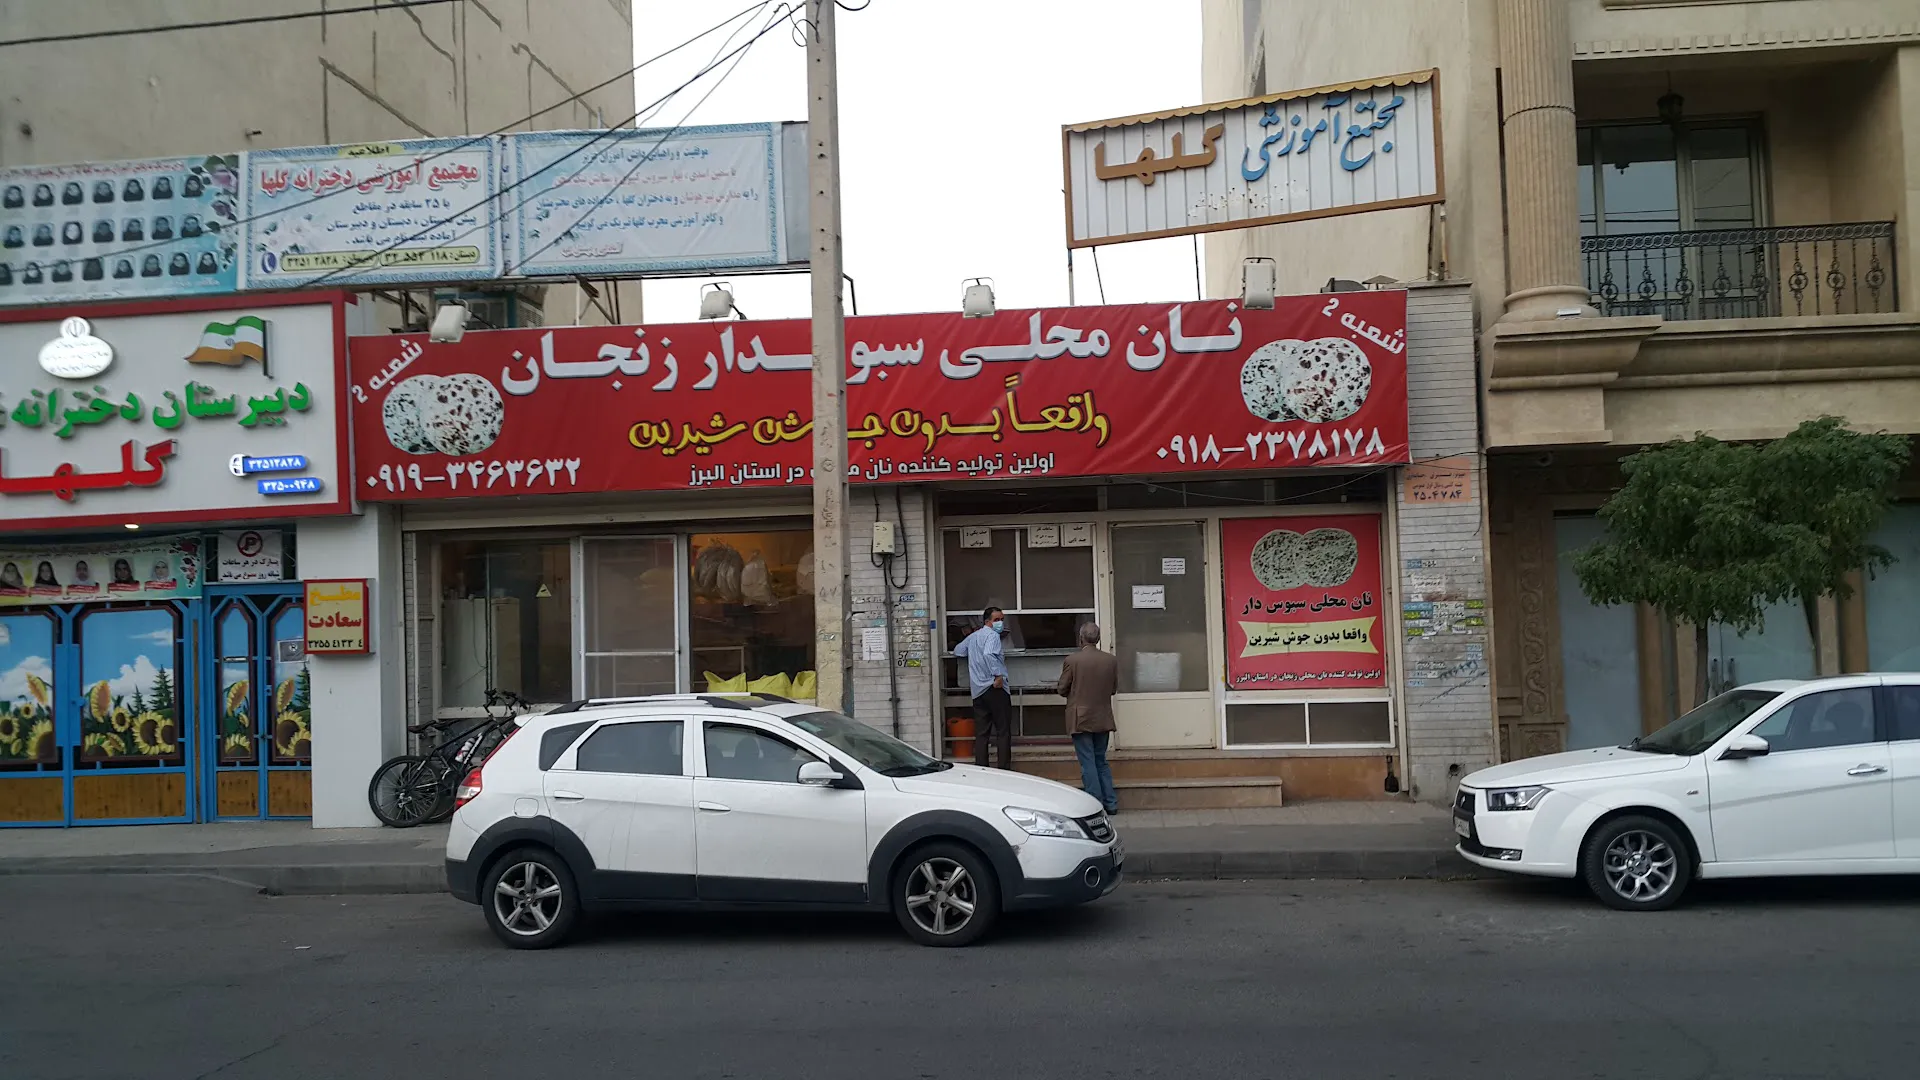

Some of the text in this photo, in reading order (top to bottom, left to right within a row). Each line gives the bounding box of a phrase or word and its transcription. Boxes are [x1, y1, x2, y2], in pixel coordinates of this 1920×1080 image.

[1094, 94, 1406, 187] مجتمع آموزشی گلها
[260, 157, 480, 197] مجتمع آموزشی دخترانه گلها
[1321, 297, 1406, 355] شعبه 2
[501, 301, 1243, 395] نان محلی سبودار زنجان
[351, 339, 424, 404] شعبه 2
[11, 386, 142, 438] دخترانه
[152, 381, 312, 429] دبیرستان
[628, 411, 748, 456] شیرین
[753, 410, 887, 449] جش
[890, 407, 1003, 454] بدون
[1156, 427, 1385, 465] ۰۹۱۸-۲۳۷۸۱۷۸
[0, 439, 177, 503] گله
[729, 462, 781, 485] استان
[785, 464, 804, 483] در
[866, 457, 892, 480] نان
[898, 453, 950, 474] کننده
[957, 453, 1003, 477] تولید
[1009, 452, 1055, 474] اولین
[366, 457, 581, 493] ۰۹۱۹-۳۴۶۳۶۳۲
[689, 464, 725, 486] البرز
[1242, 591, 1373, 615] نان محلی سبوس دار
[309, 611, 362, 628] سعادت
[1249, 629, 1367, 646] واقعا بدون جوش شیرین
[1236, 673, 1250, 683] البرز
[1251, 673, 1268, 682] استان
[1278, 673, 1298, 681] زنجان
[1299, 672, 1316, 681] محلی
[1328, 670, 1346, 678] کننده
[1347, 671, 1363, 679] تولید
[1364, 670, 1380, 678] اولین
